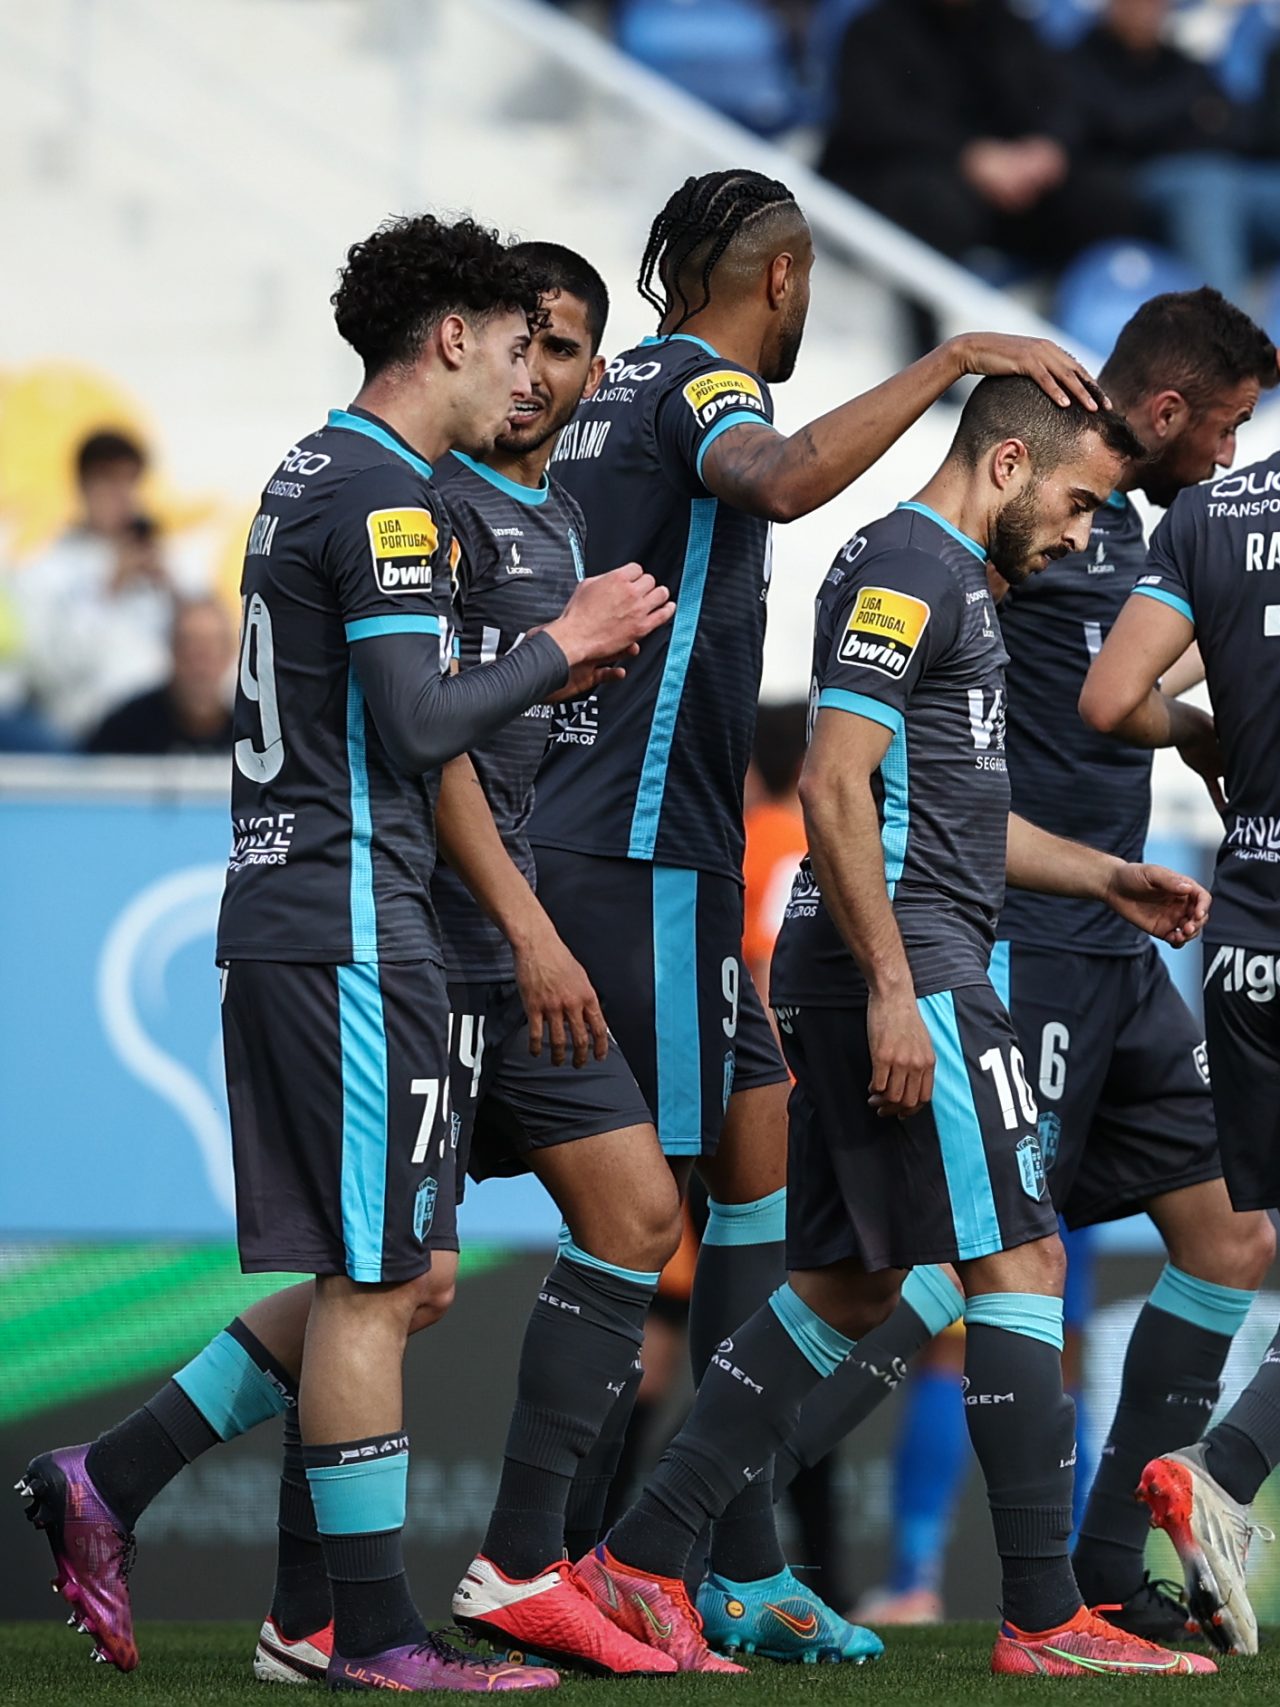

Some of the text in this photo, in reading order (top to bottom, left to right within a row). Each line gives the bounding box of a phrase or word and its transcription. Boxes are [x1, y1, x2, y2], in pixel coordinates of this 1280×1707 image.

[377, 519, 402, 534] LIGA
[856, 611, 906, 634] PORTUGAL
[861, 596, 882, 611] LIGA
[841, 634, 906, 672] bwin
[721, 956, 740, 1038] 9
[1038, 1021, 1070, 1101] 6
[979, 1046, 1038, 1130] 10
